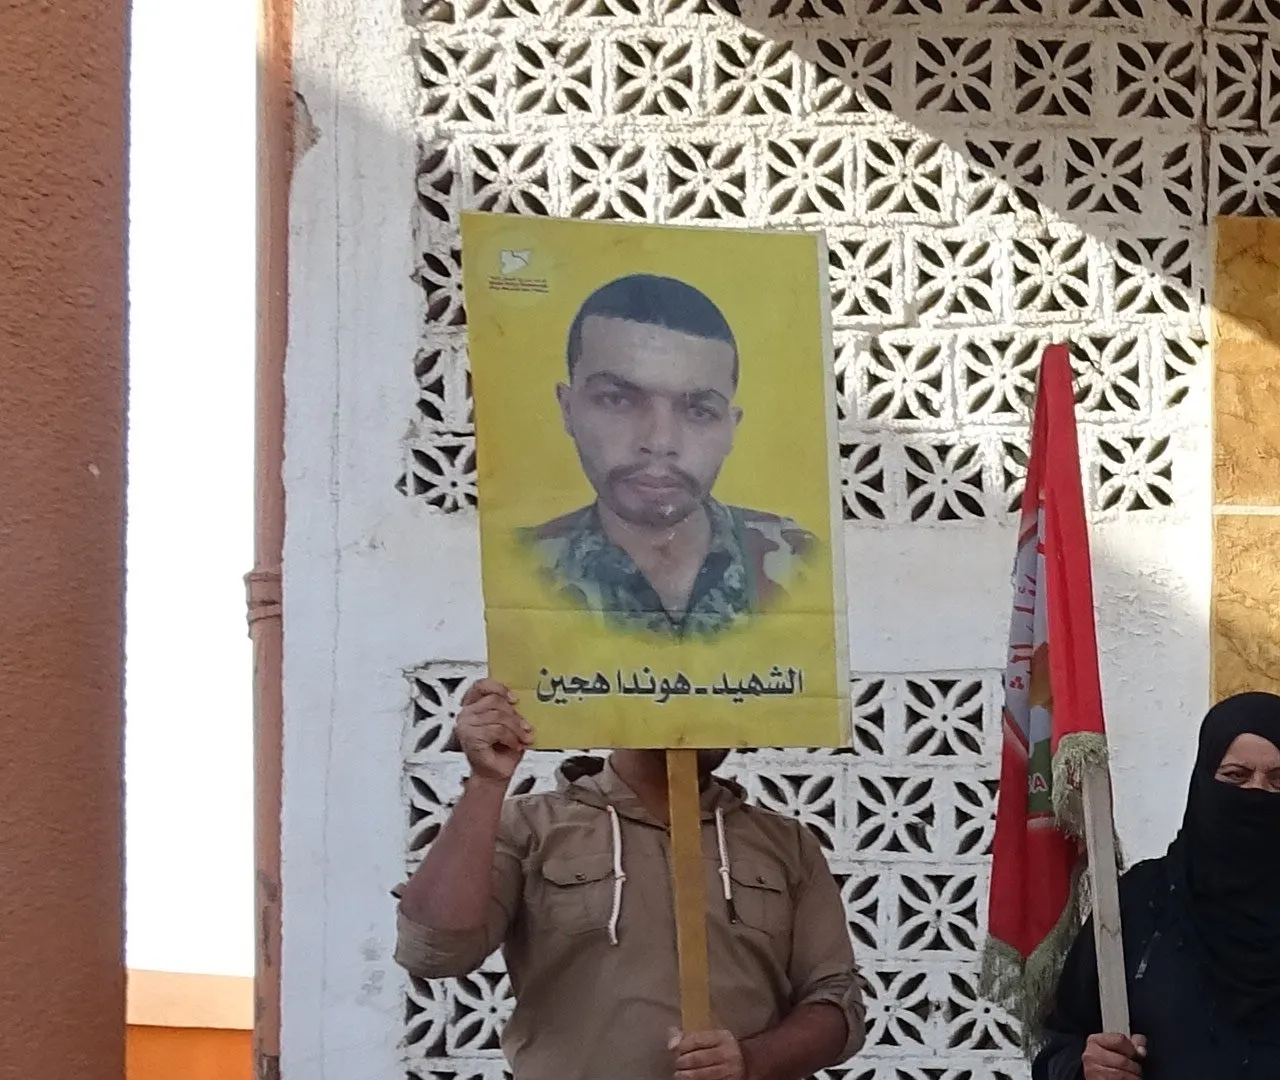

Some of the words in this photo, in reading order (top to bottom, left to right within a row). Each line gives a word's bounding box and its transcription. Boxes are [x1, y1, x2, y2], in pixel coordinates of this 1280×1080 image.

[536, 667, 610, 704] هجين
[617, 666, 691, 703] هوندا
[712, 666, 804, 703] الشهيد
